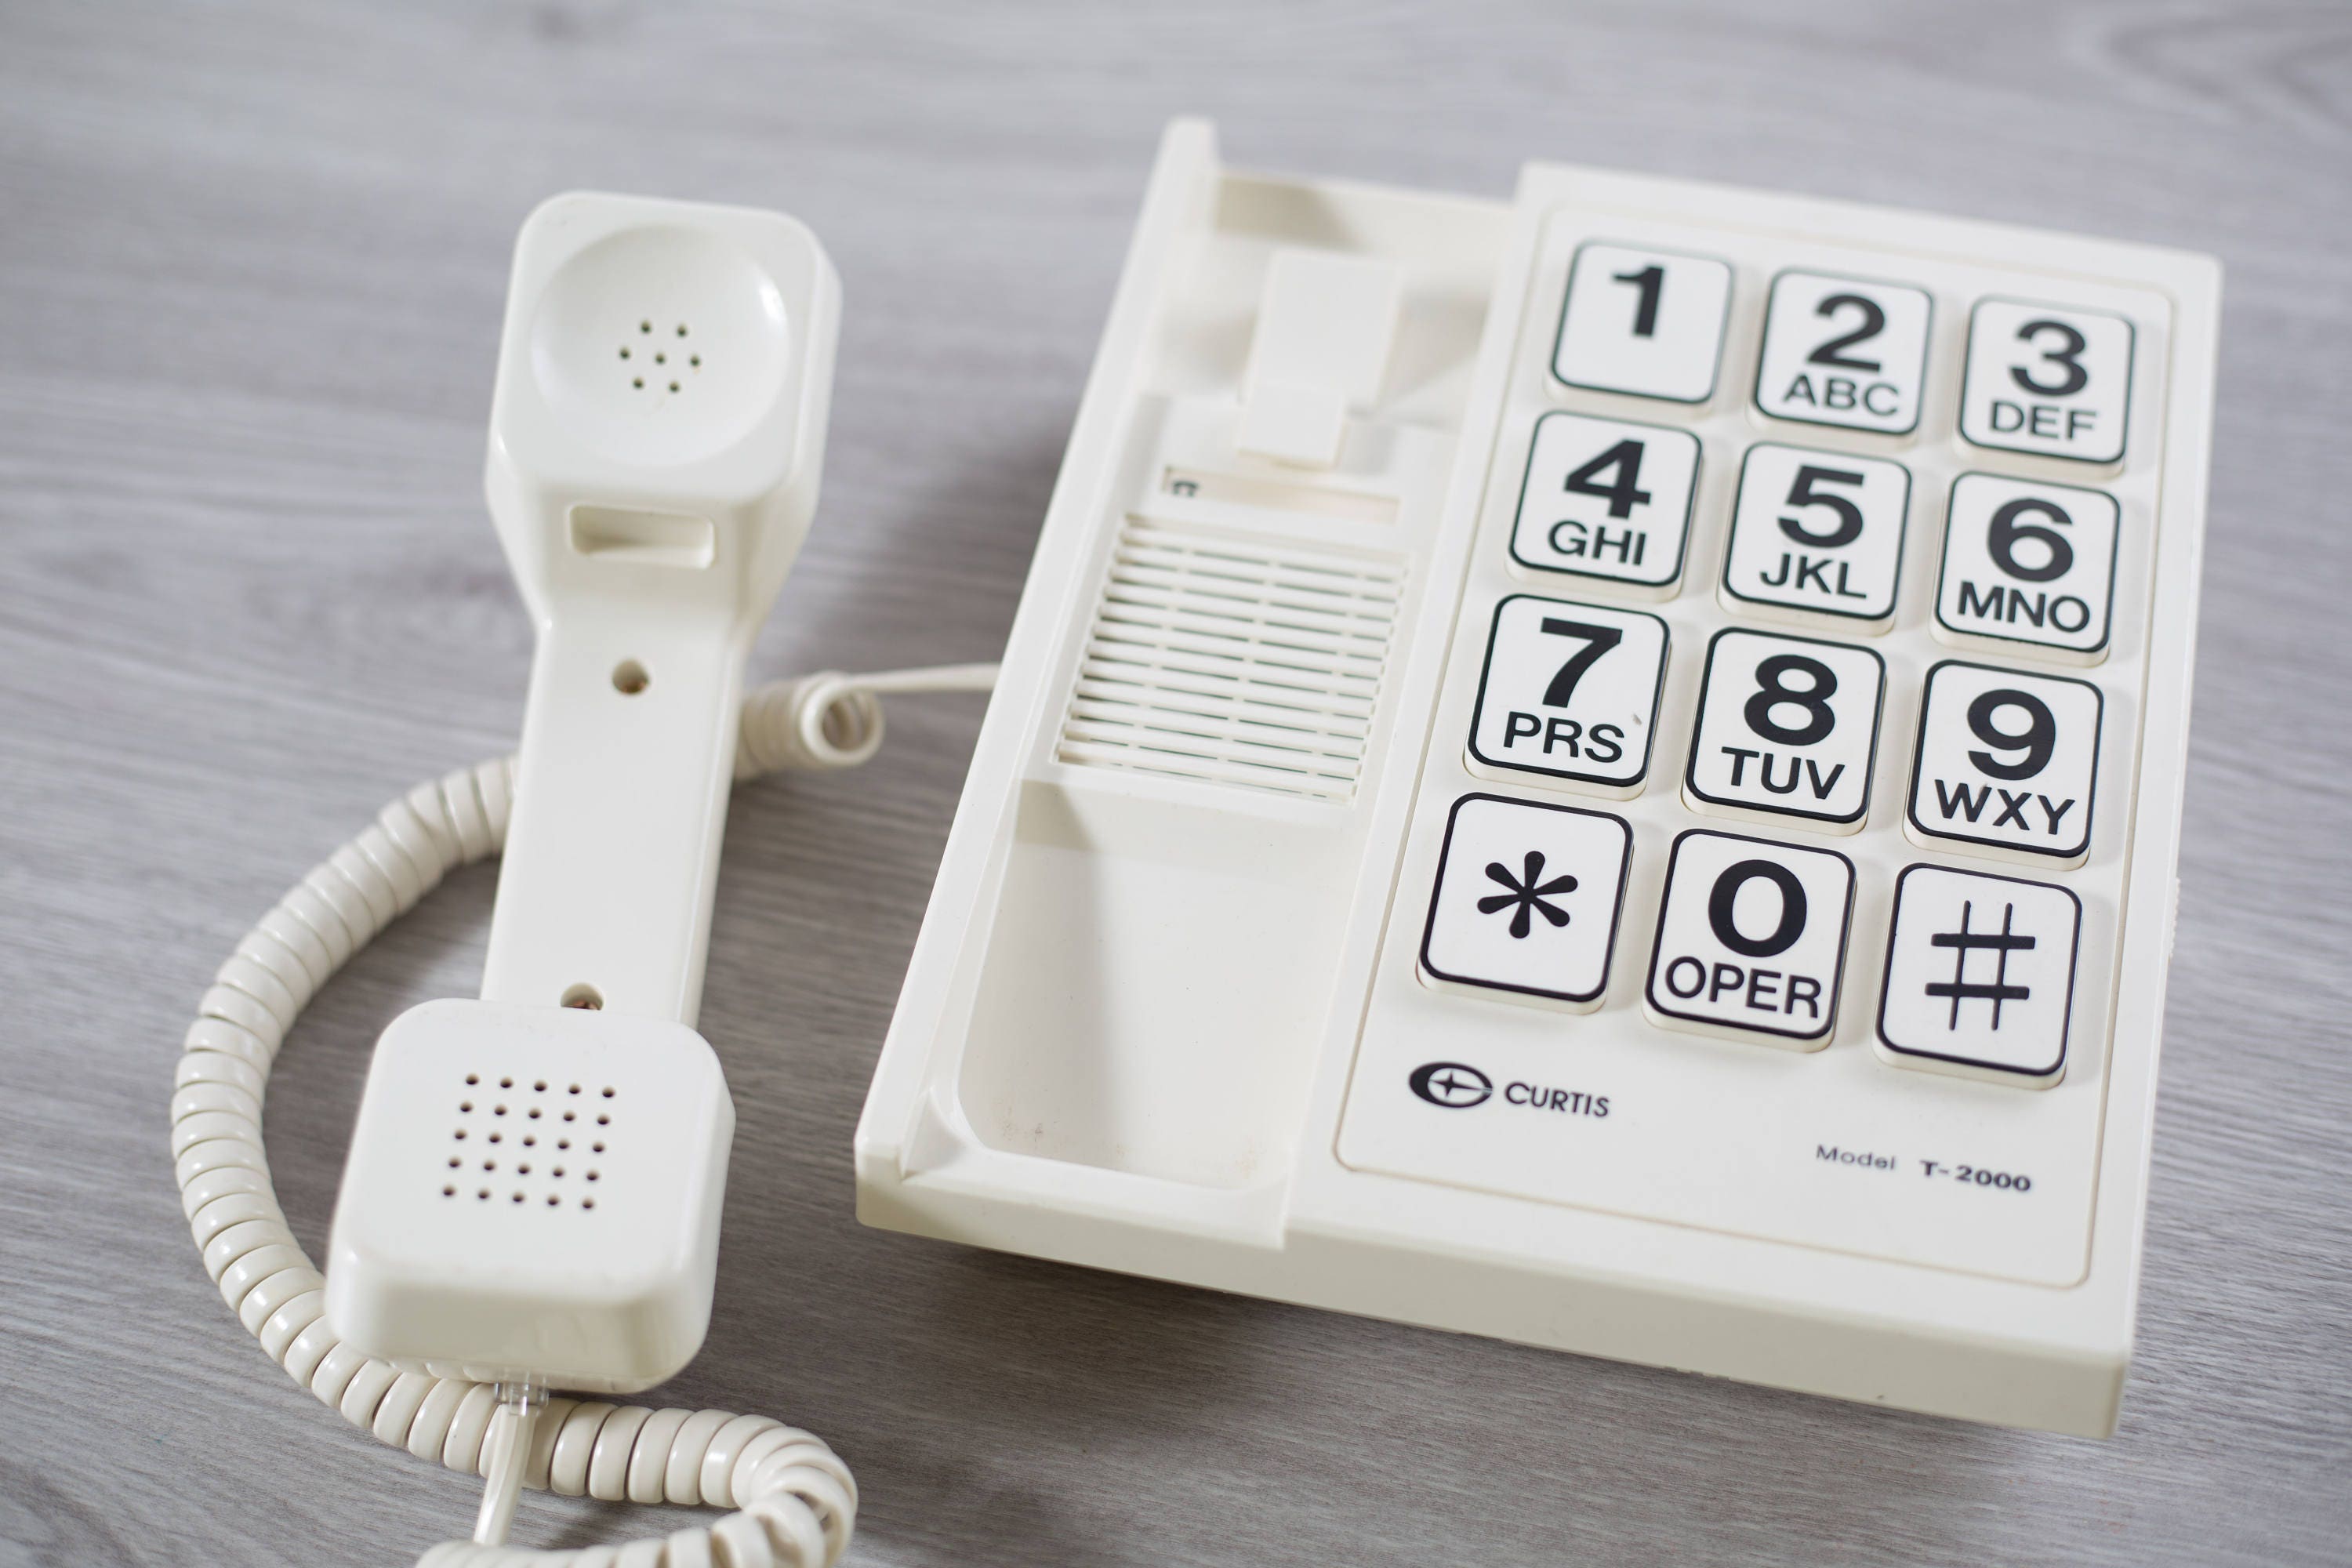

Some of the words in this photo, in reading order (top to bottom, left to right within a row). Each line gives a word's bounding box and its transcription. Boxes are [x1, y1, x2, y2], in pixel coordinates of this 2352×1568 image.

[1611, 265, 1665, 338] 1
[1806, 293, 1886, 373] 2
[2010, 320, 2089, 397] 3
[1782, 373, 1900, 416] ABC
[1990, 400, 2097, 441] DEF
[1563, 439, 1652, 520] 4
[1777, 464, 1864, 549] 5
[1548, 520, 1646, 566] GHI
[1987, 497, 2074, 583] 6
[1760, 553, 1867, 599] JKL
[1958, 580, 2091, 633] MNO
[1540, 616, 1624, 709] 7
[1743, 654, 1838, 746] 8
[1503, 710, 1625, 764] PRS
[1966, 688, 2056, 782] 9
[1721, 746, 1846, 800] TUV
[1934, 779, 2076, 836] WXY
[1708, 858, 1808, 958] 0
[1664, 956, 1822, 1019] OPER
[1504, 1081, 1610, 1117] CURTIS
[1816, 1145, 1896, 1171] Model
[1920, 1160, 2032, 1192] T-2000
